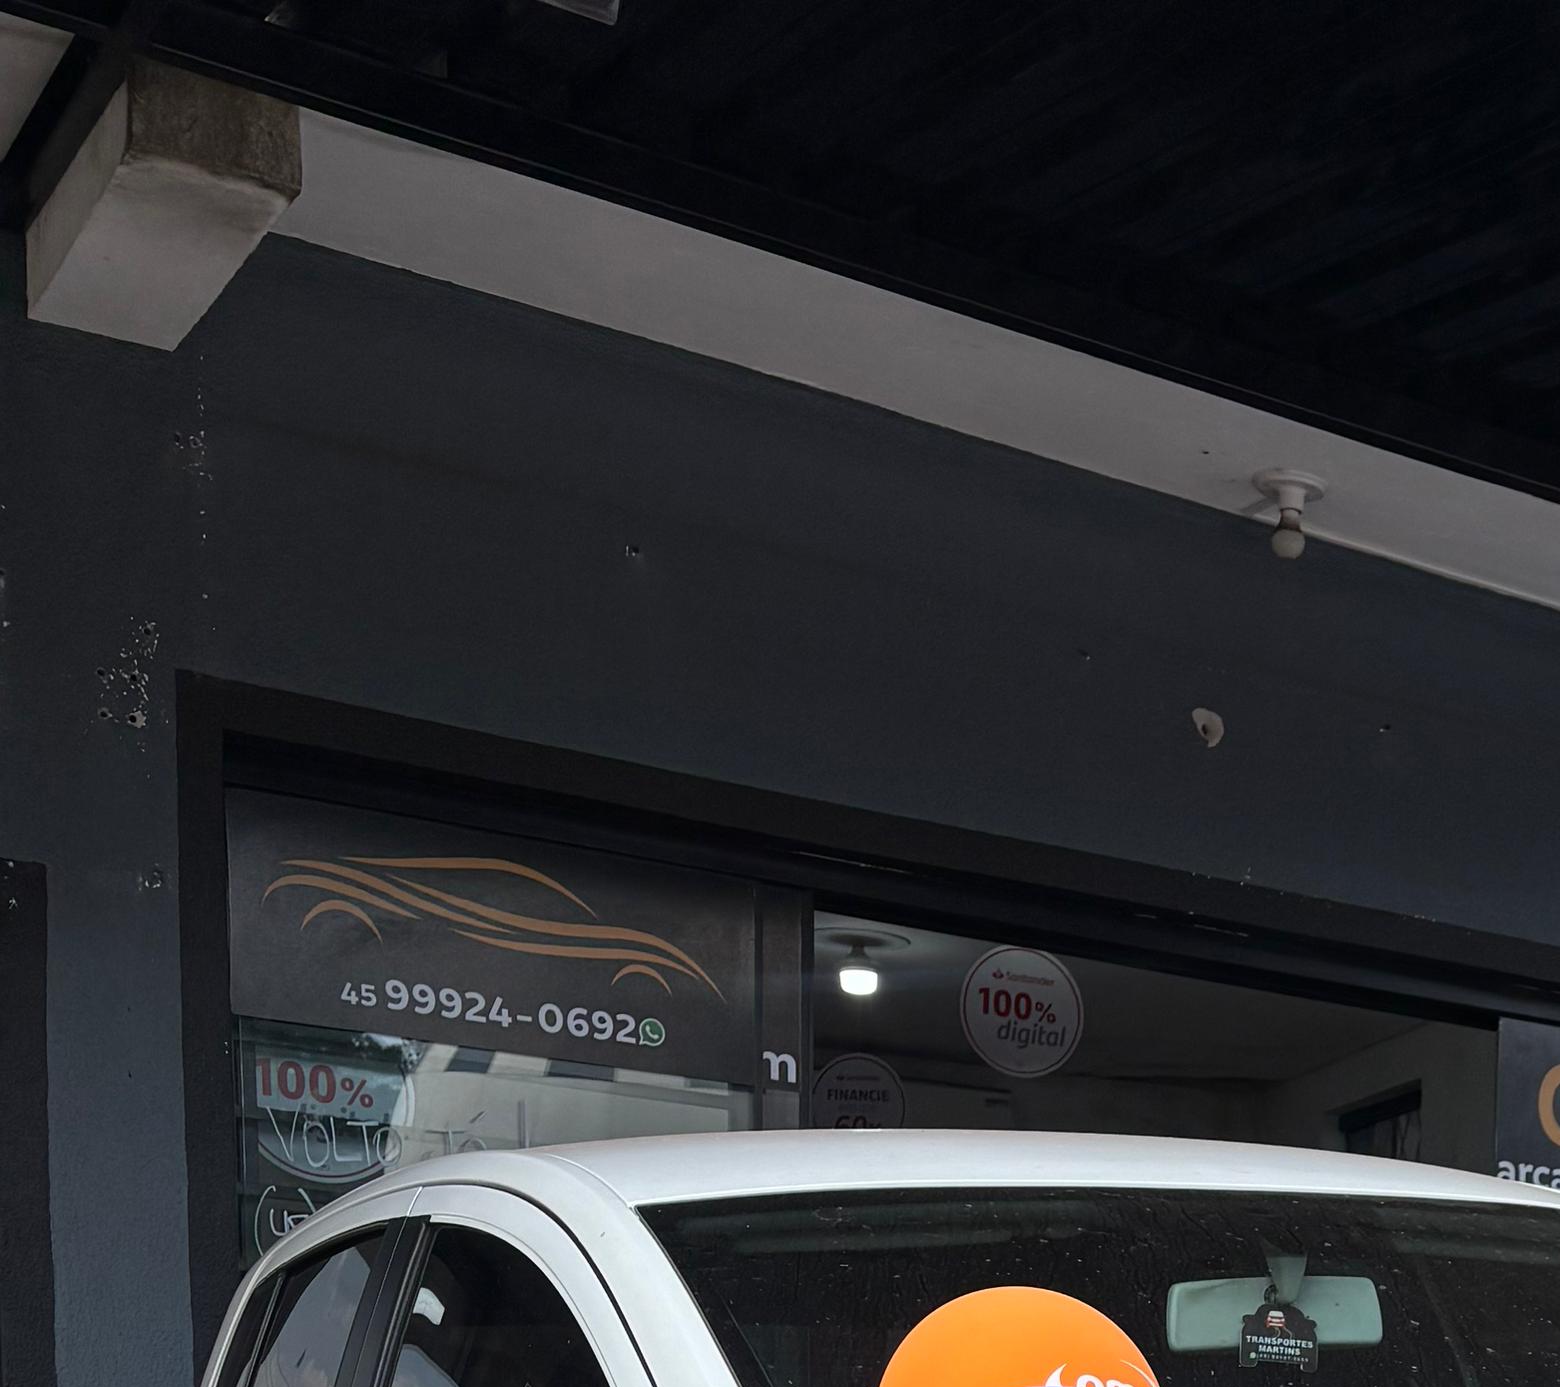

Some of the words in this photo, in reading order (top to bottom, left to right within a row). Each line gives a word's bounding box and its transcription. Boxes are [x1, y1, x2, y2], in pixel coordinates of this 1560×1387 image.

[340, 982, 378, 1007] 45
[384, 978, 638, 1045] 99924-0692
[978, 987, 1056, 1024] 100%
[997, 1019, 1066, 1049] digital
[256, 1058, 374, 1108] 100%
[265, 1105, 402, 1168] VOLTO
[1246, 1335, 1314, 1349] TRANSPORTES
[1258, 1344, 1302, 1356] MARTINS
